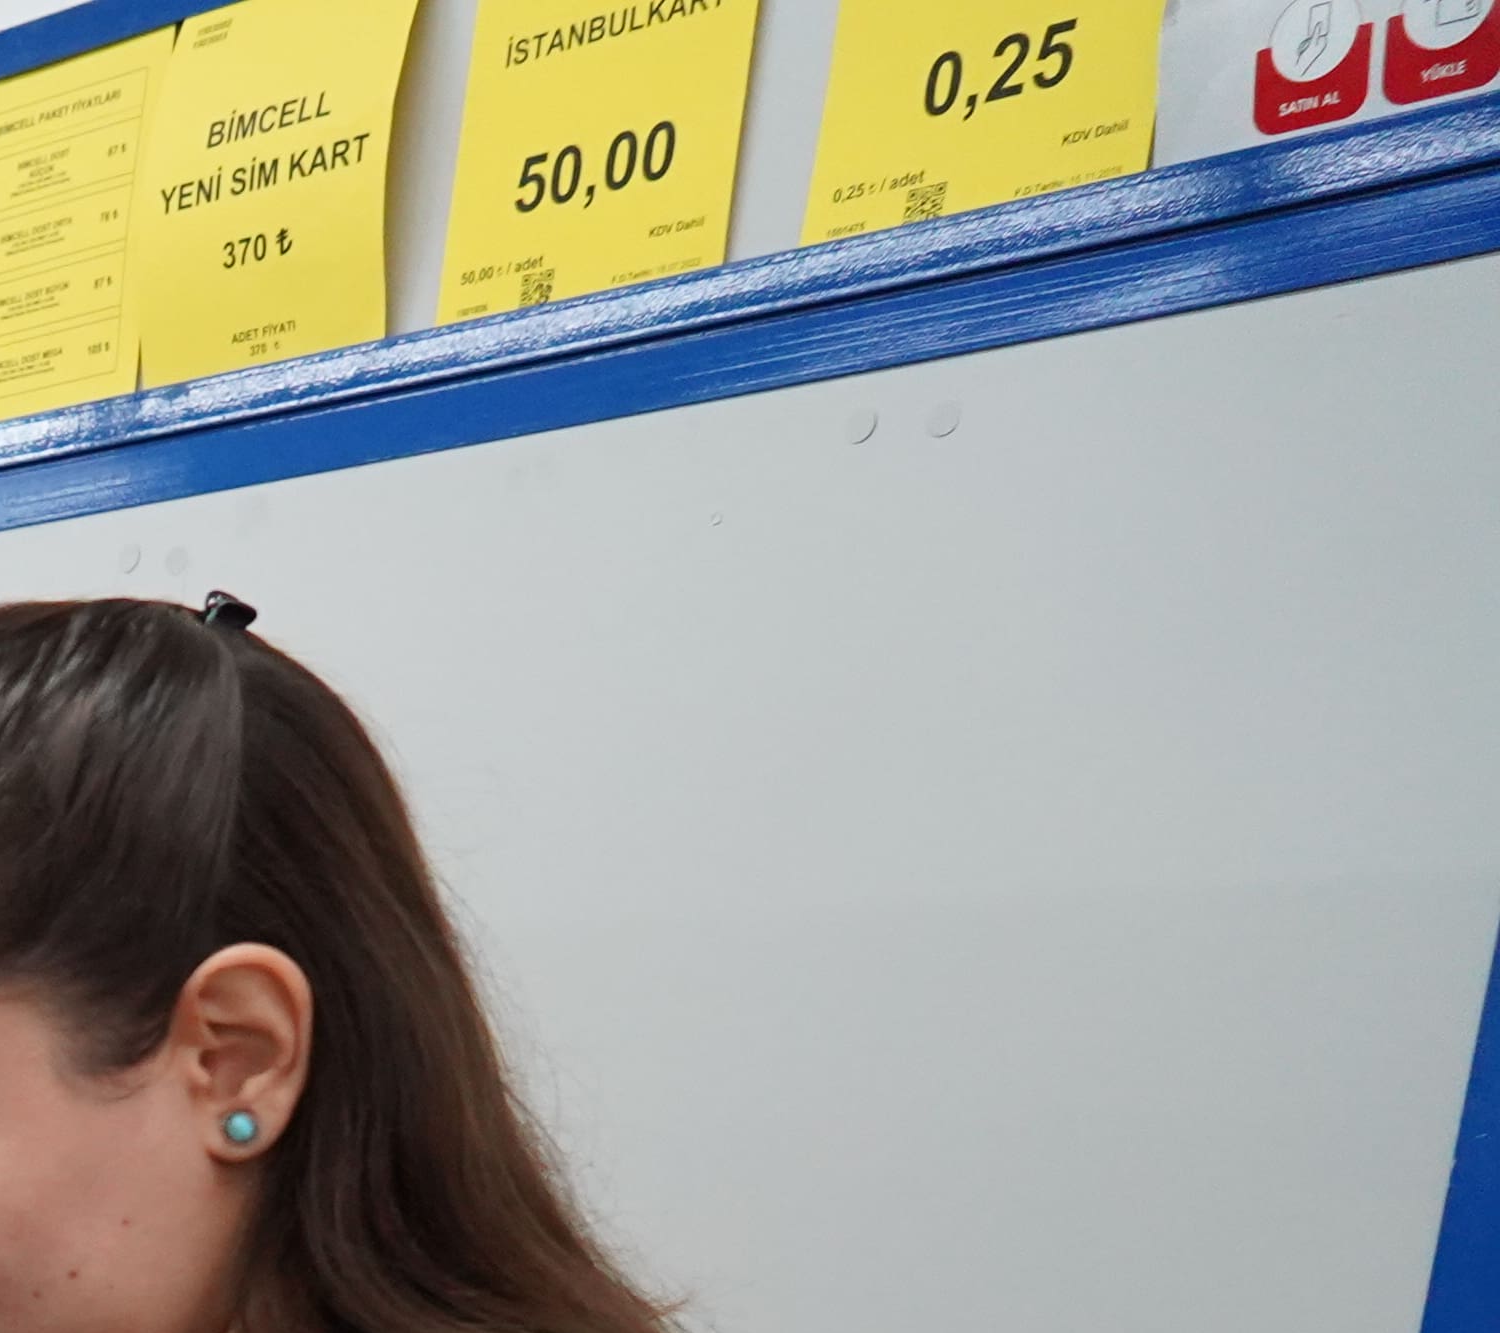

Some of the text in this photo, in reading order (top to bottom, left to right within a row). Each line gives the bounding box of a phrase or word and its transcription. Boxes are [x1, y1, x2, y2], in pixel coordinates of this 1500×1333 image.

[505, 0, 722, 68] İSTANBULKAR
[923, 17, 1079, 121] 0,25
[207, 91, 331, 149] BİMCELL
[1278, 91, 1341, 117] SATIN AL
[1061, 119, 1130, 147] KDV Dahil
[161, 132, 371, 215] YENİ SİM KART
[514, 120, 676, 213] 50,00
[889, 170, 925, 190] adet
[223, 227, 293, 269] 370 ₺
[649, 224, 673, 239] KDV
[460, 265, 494, 286] 50,00
[515, 255, 544, 272] adet
[231, 320, 296, 344] ADET FİYATI
